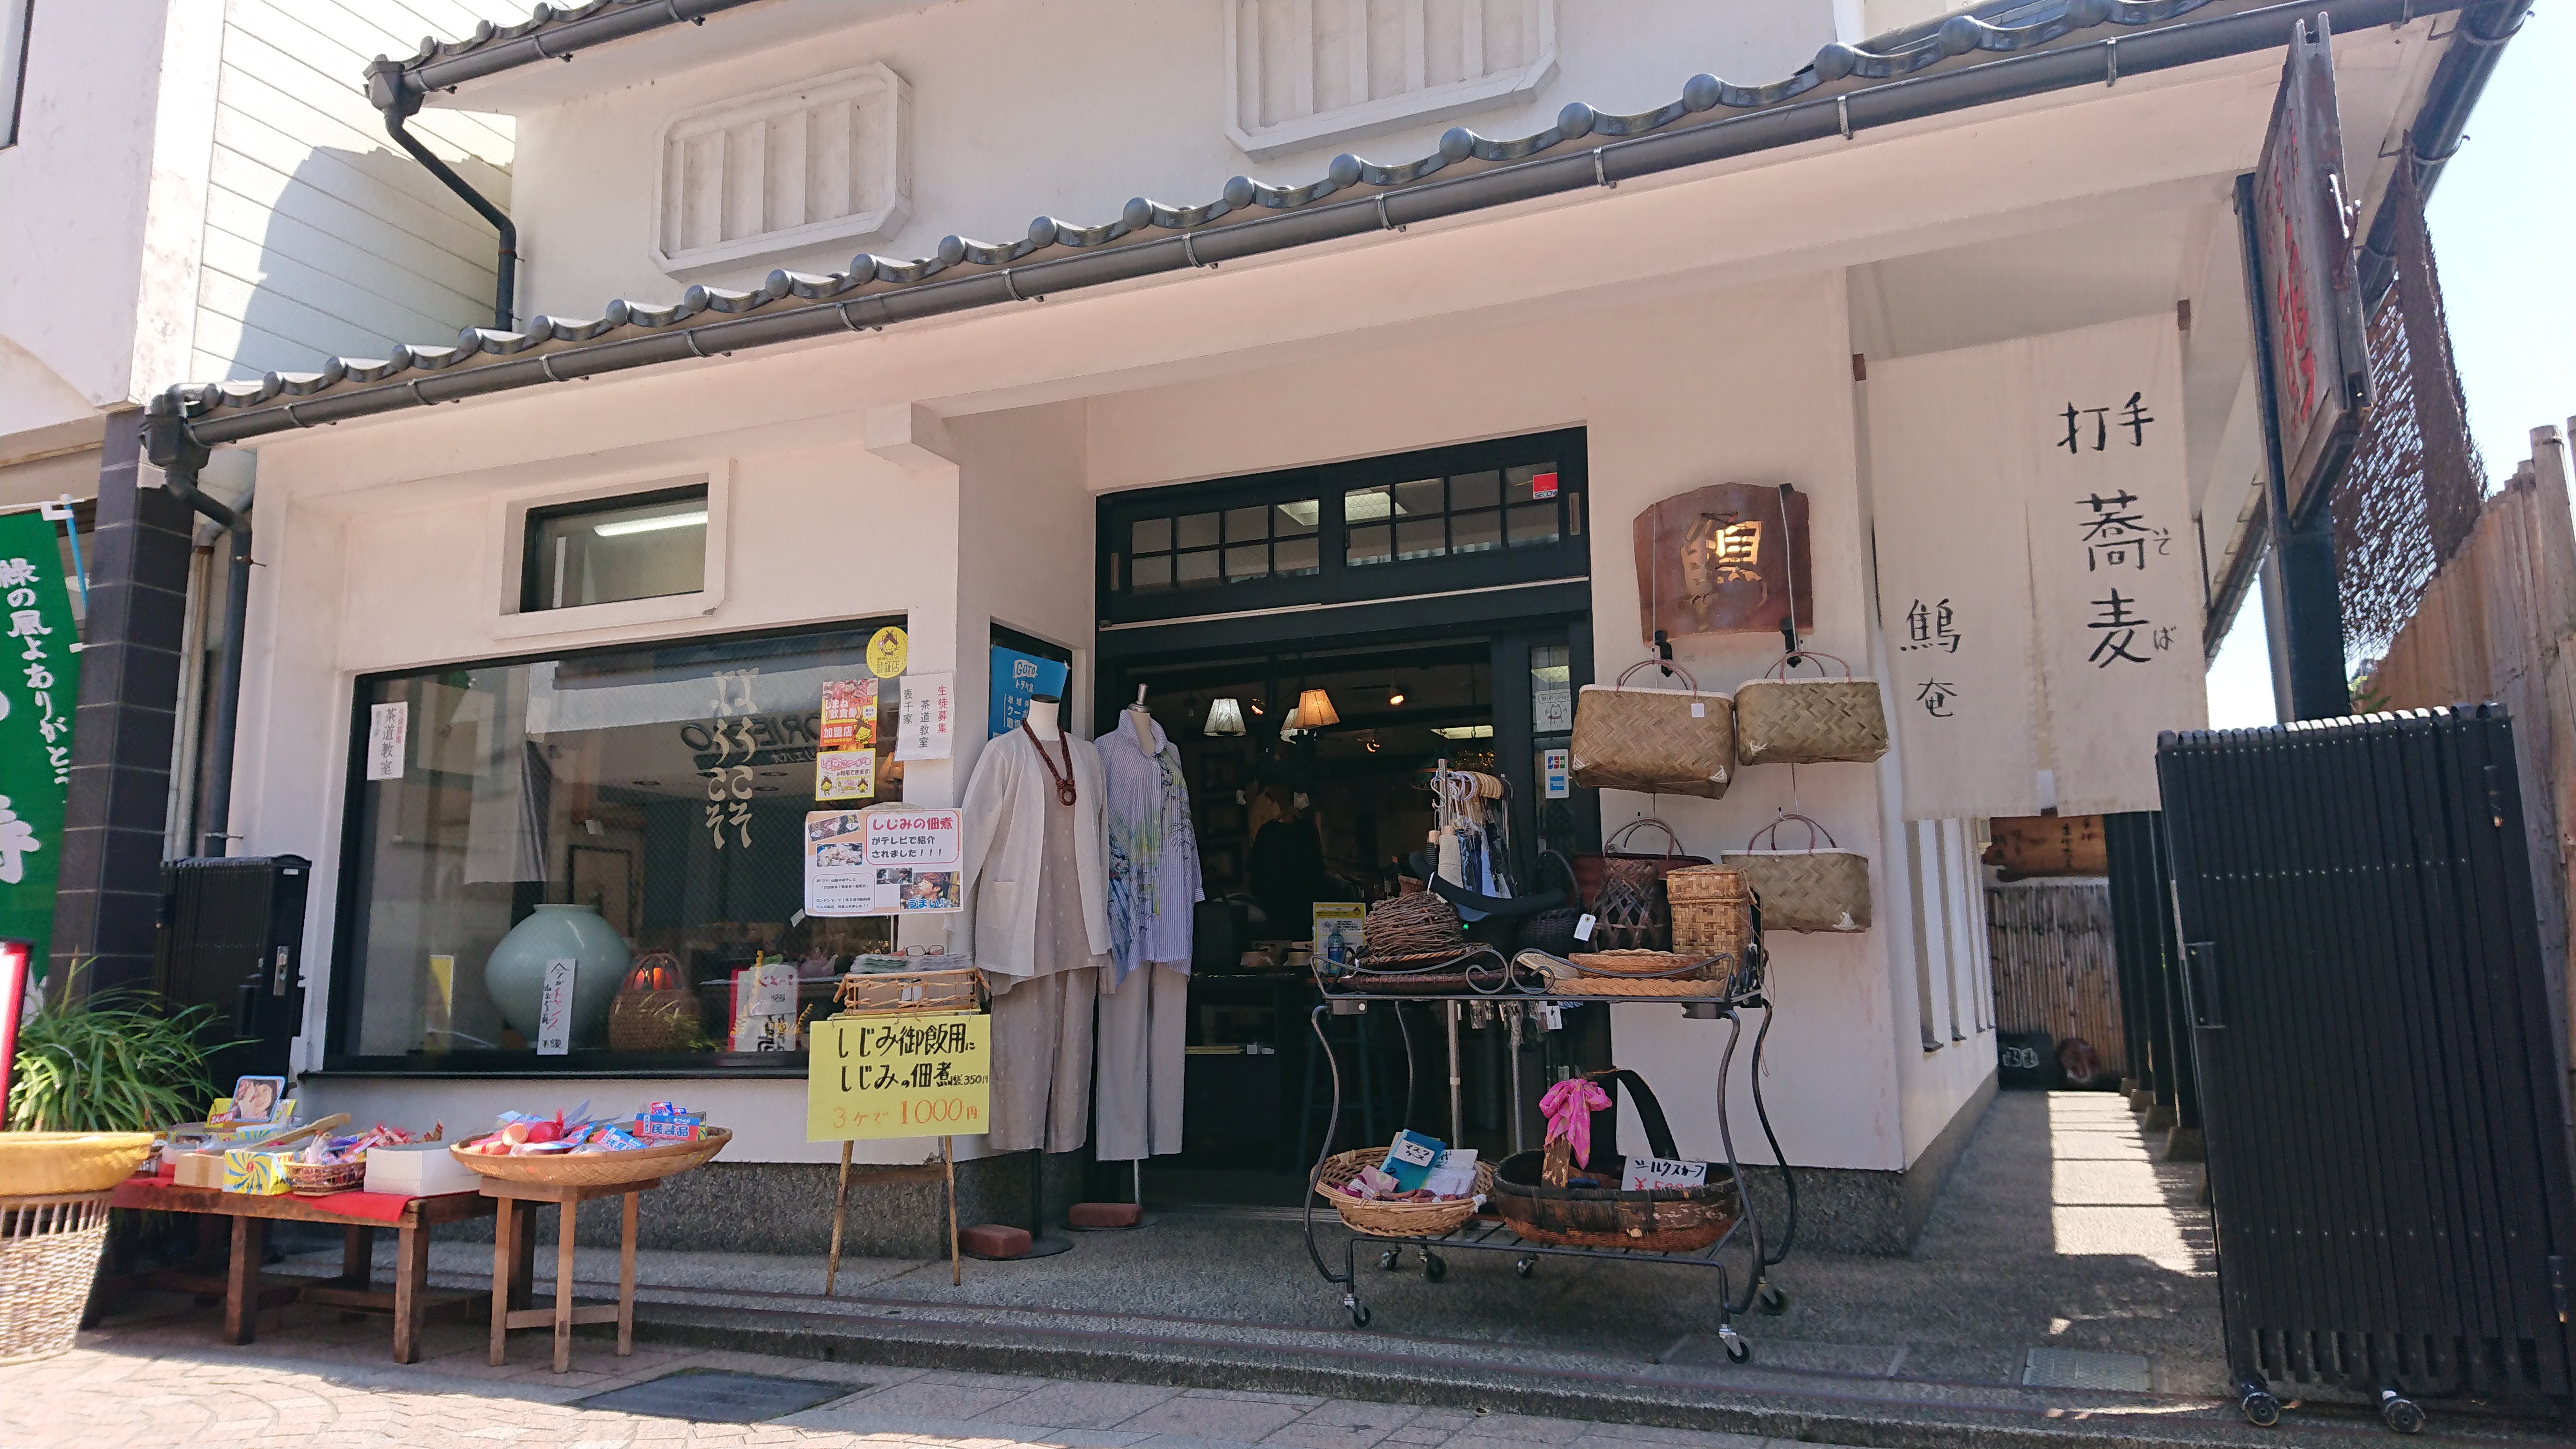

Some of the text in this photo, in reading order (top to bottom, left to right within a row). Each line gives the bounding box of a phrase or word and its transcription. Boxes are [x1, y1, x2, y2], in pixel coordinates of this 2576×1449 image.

[1535, 490, 1557, 498] SECOM
[2074, 489, 2152, 668] 蕎麦
[876, 660, 900, 673] 認証店
[1015, 679, 1034, 693] トラベル
[825, 699, 848, 710] しまね
[903, 688, 913, 725] 表千家
[937, 685, 948, 734] 生徒募集
[829, 708, 857, 719] 飲食券
[917, 699, 930, 748] 茶道教室
[823, 725, 853, 738] 加盟店
[380, 707, 397, 776] 茶道教室
[1548, 755, 1566, 769] JCB
[872, 817, 953, 831] しじみの佃煮
[871, 835, 936, 845] がテレビで紹介
[838, 1022, 976, 1059] しじみ御飯用に
[841, 1061, 952, 1092] しじみの佃煮
[900, 1098, 978, 1125] 1000円
[1405, 1142, 1430, 1156] マスク
[1405, 1150, 1424, 1162] ケース
